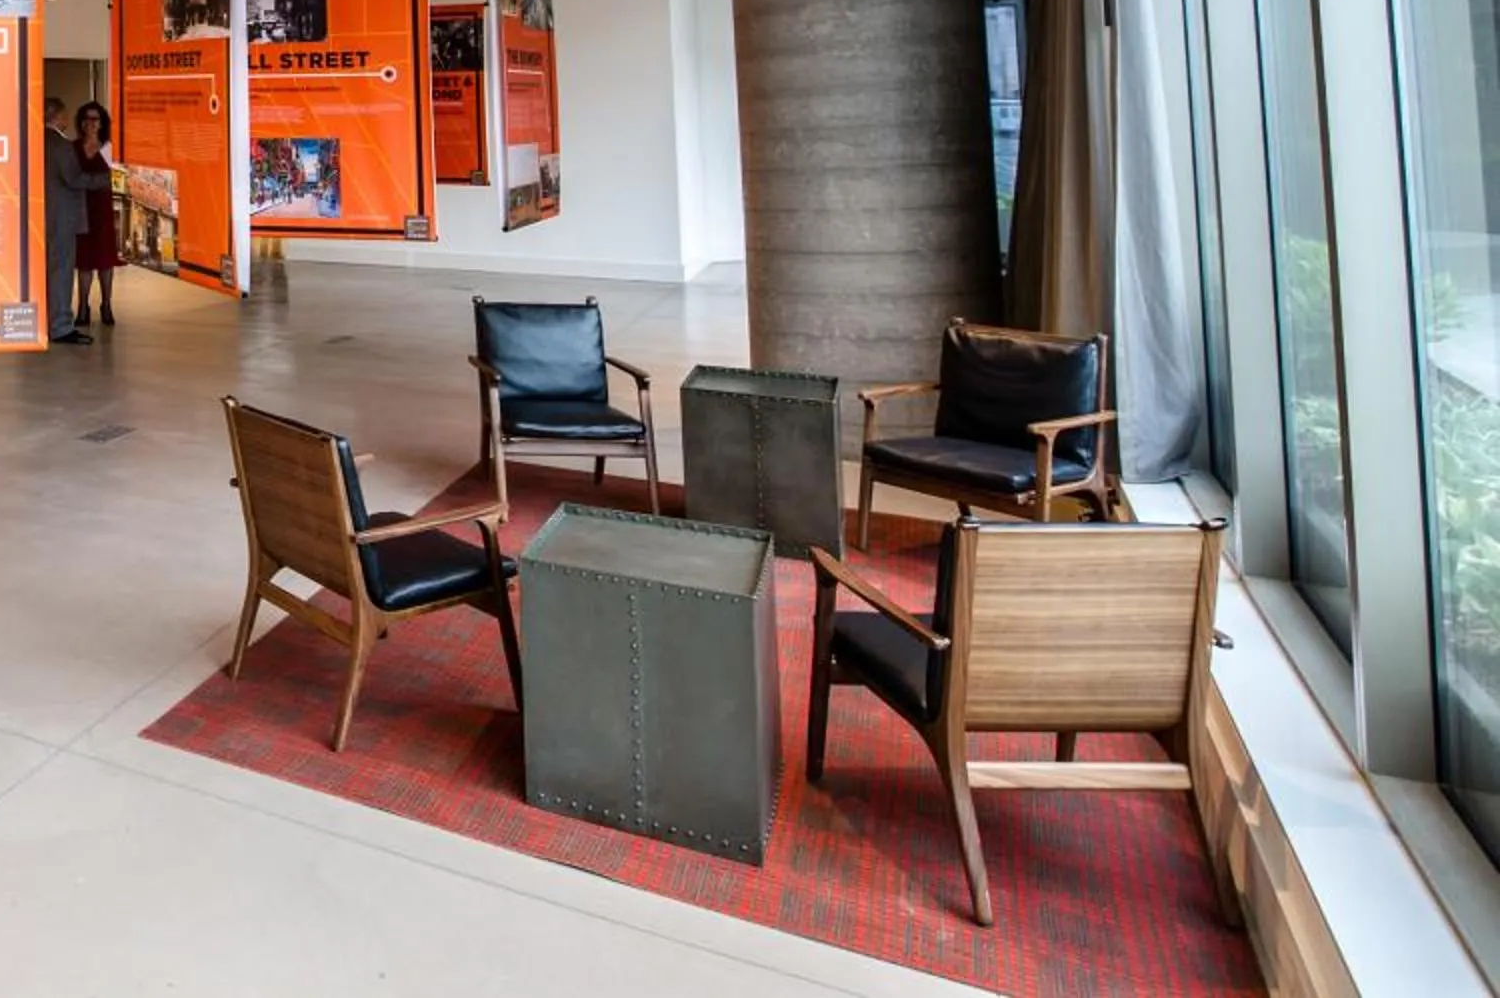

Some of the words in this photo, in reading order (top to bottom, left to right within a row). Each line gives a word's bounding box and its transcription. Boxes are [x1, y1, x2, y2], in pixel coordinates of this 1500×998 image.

[163, 50, 202, 69] STREET
[248, 53, 272, 70] LL
[280, 52, 370, 69] STREET
[432, 75, 460, 88] EET
